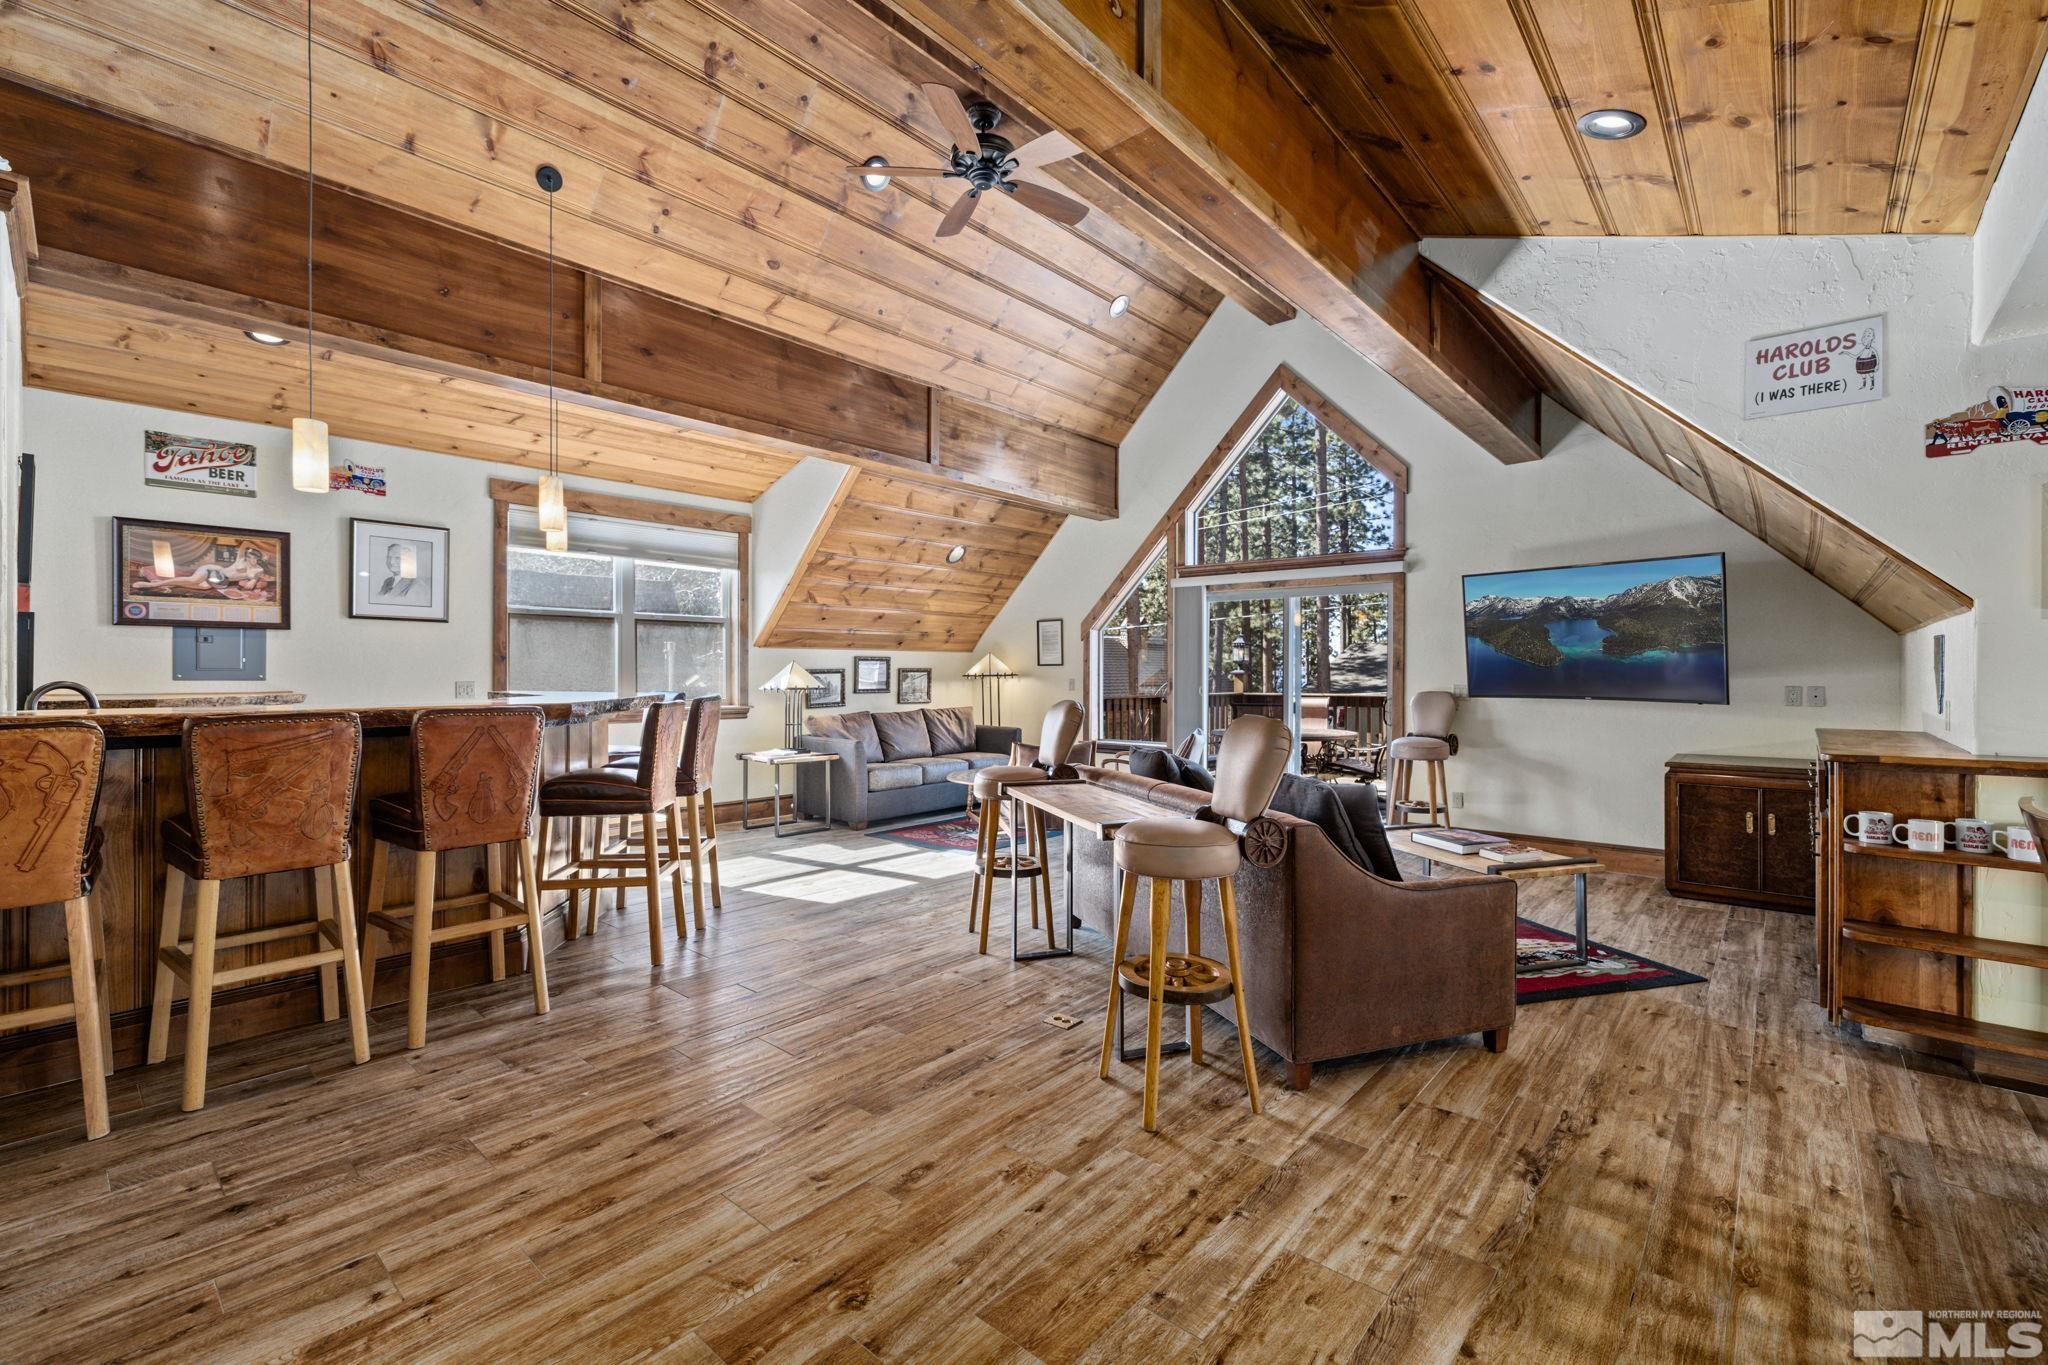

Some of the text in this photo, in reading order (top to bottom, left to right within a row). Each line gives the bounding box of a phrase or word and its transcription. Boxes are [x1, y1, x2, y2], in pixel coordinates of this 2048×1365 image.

[1756, 333, 1857, 365] HAROLDS
[1772, 357, 1831, 381] CLUB
[1769, 387, 1795, 401] WAS
[1800, 378, 1847, 397] THERE)
[153, 442, 252, 474] Tahoe
[209, 467, 245, 482] BEER
[1911, 831, 1940, 842] RENO
[2010, 839, 2037, 850] REN
